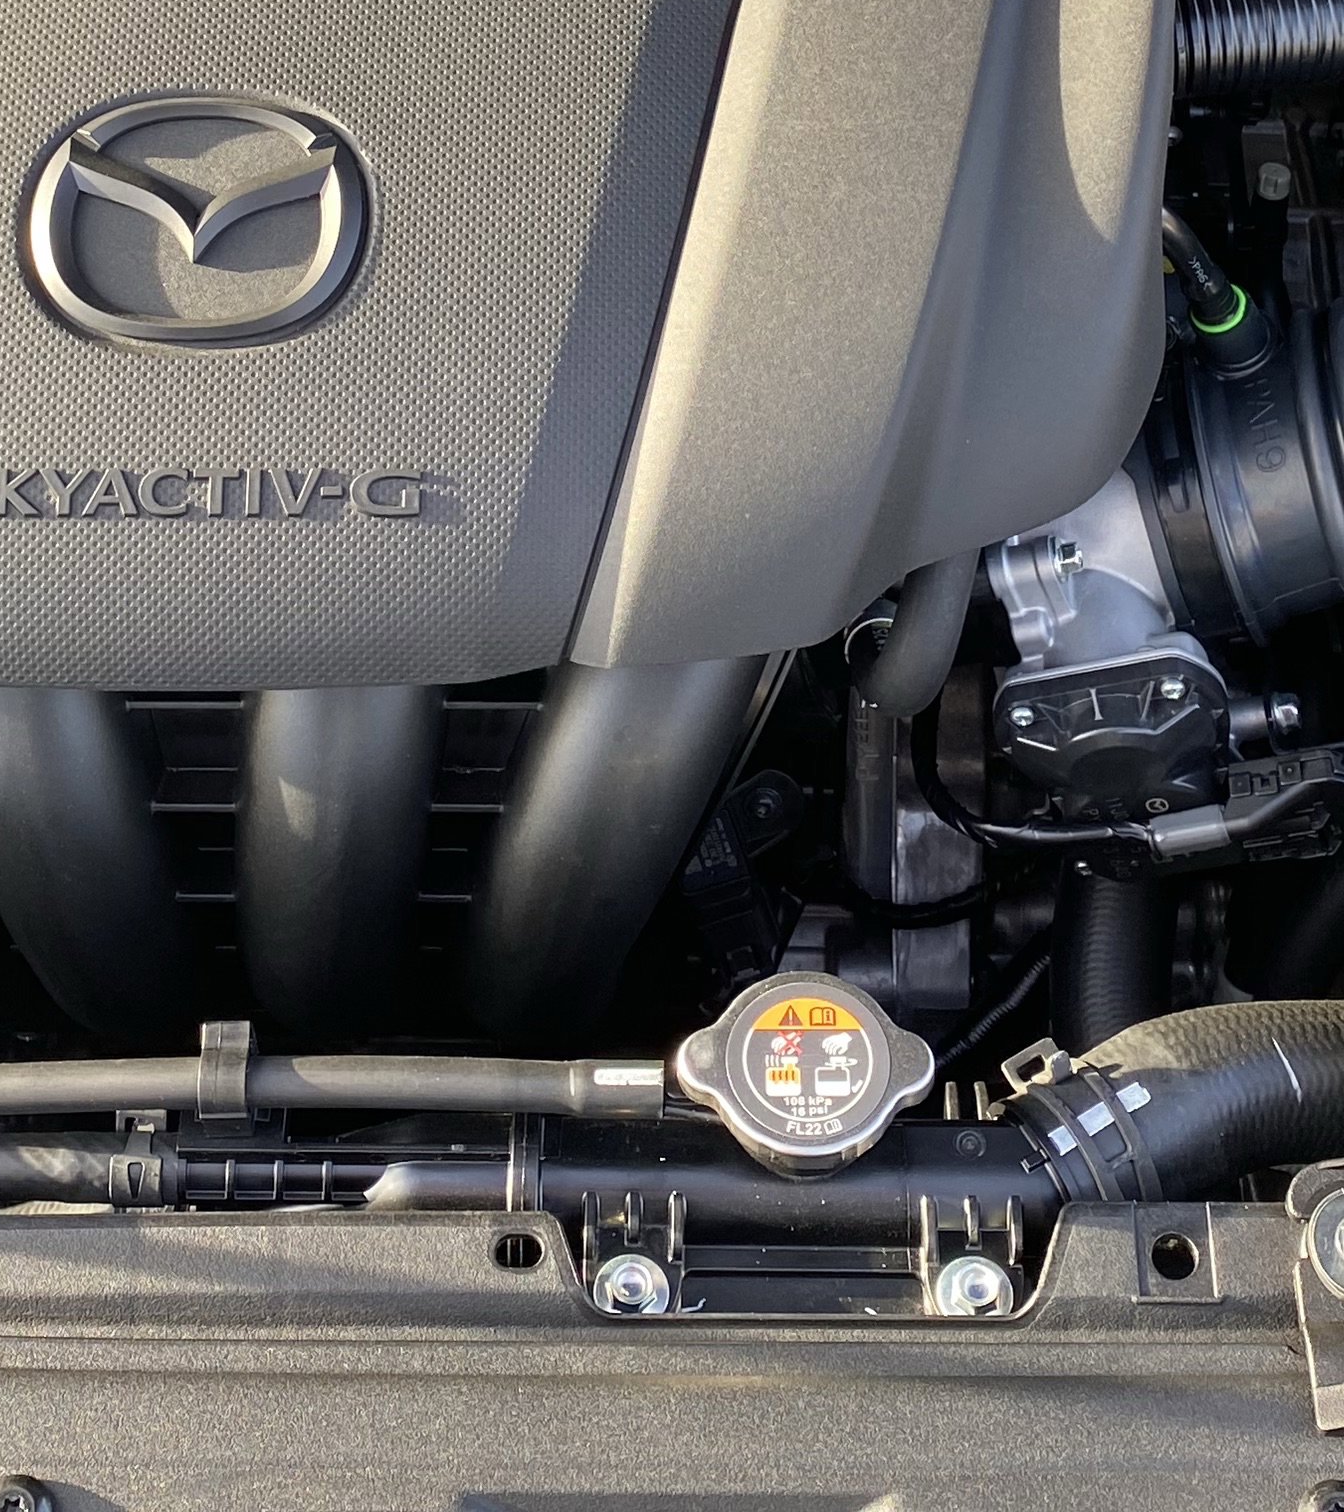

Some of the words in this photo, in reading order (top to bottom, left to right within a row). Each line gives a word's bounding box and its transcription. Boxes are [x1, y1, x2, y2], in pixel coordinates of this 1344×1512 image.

[783, 1097, 805, 1107] 108
[808, 1096, 833, 1107] kPa
[786, 1121, 823, 1136] FL22
